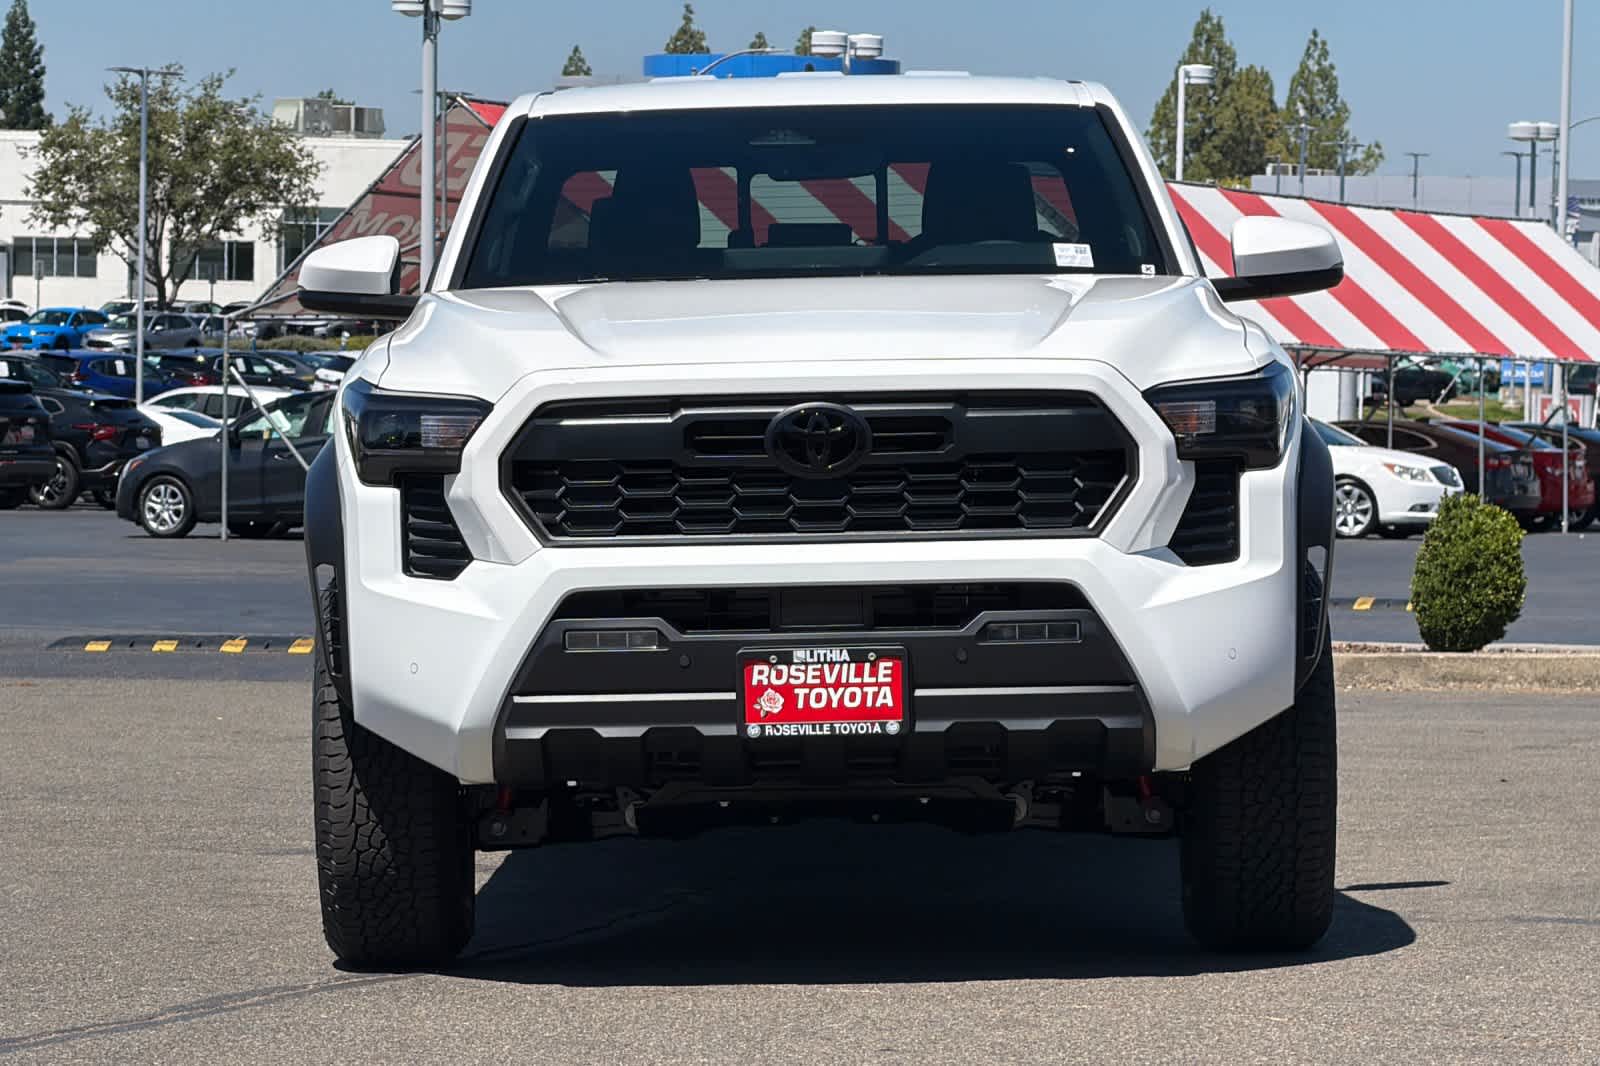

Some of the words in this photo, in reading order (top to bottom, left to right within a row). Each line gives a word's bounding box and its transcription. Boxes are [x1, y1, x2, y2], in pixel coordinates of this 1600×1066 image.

[806, 649, 850, 662] LITHIA
[751, 662, 892, 686] ROSEVILLE
[794, 686, 894, 709] TOYOTA
[765, 723, 831, 736] ROSEVILLE
[834, 722, 882, 735] TOYOTA
